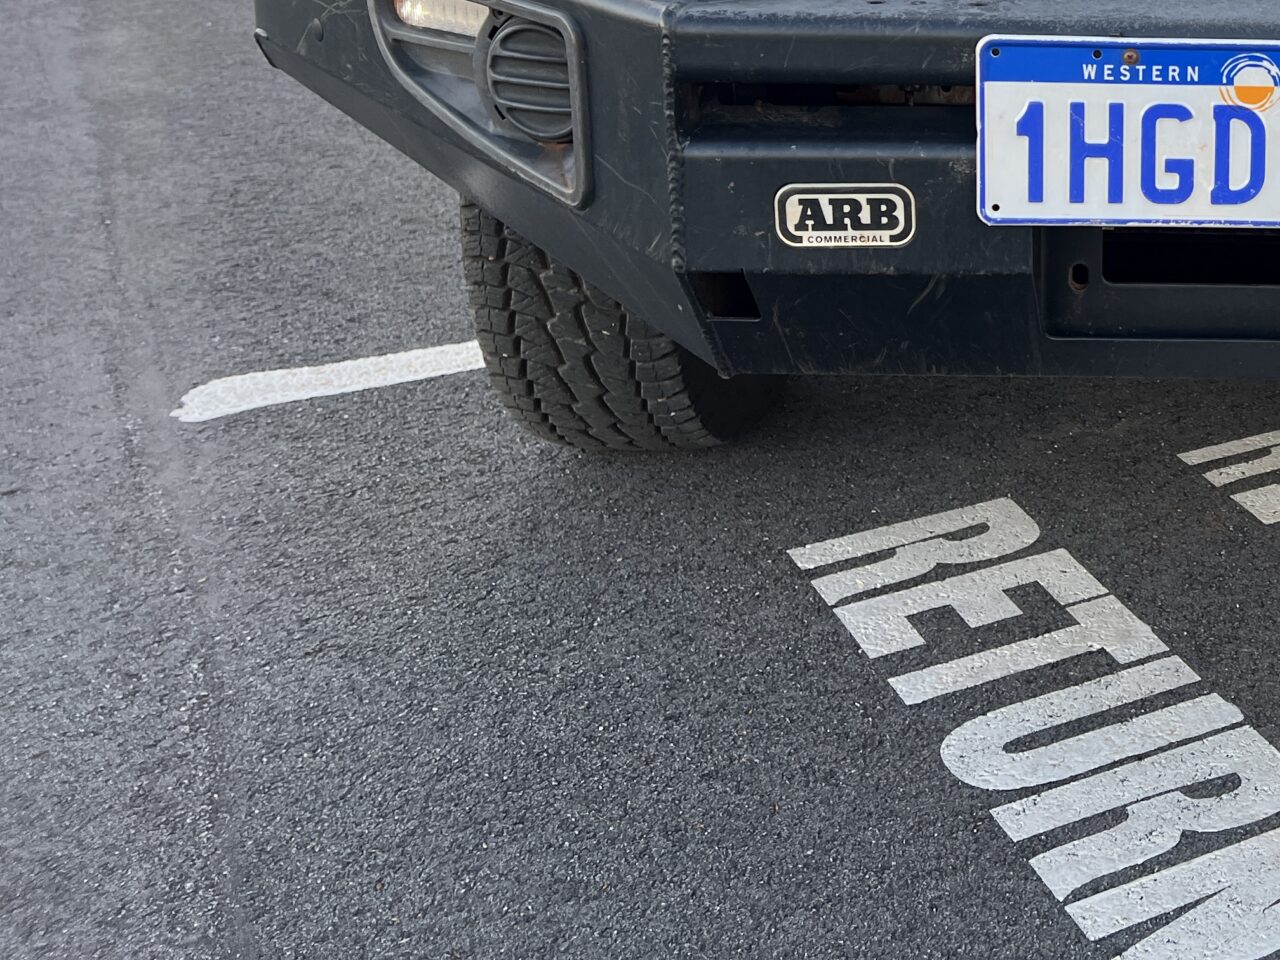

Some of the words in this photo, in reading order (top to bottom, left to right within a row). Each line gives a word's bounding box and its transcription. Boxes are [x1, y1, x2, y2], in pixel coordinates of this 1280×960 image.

[1083, 64, 1199, 82] WESTERN
[795, 198, 899, 231] ARB
[807, 235, 884, 243] COMMERCIAL
